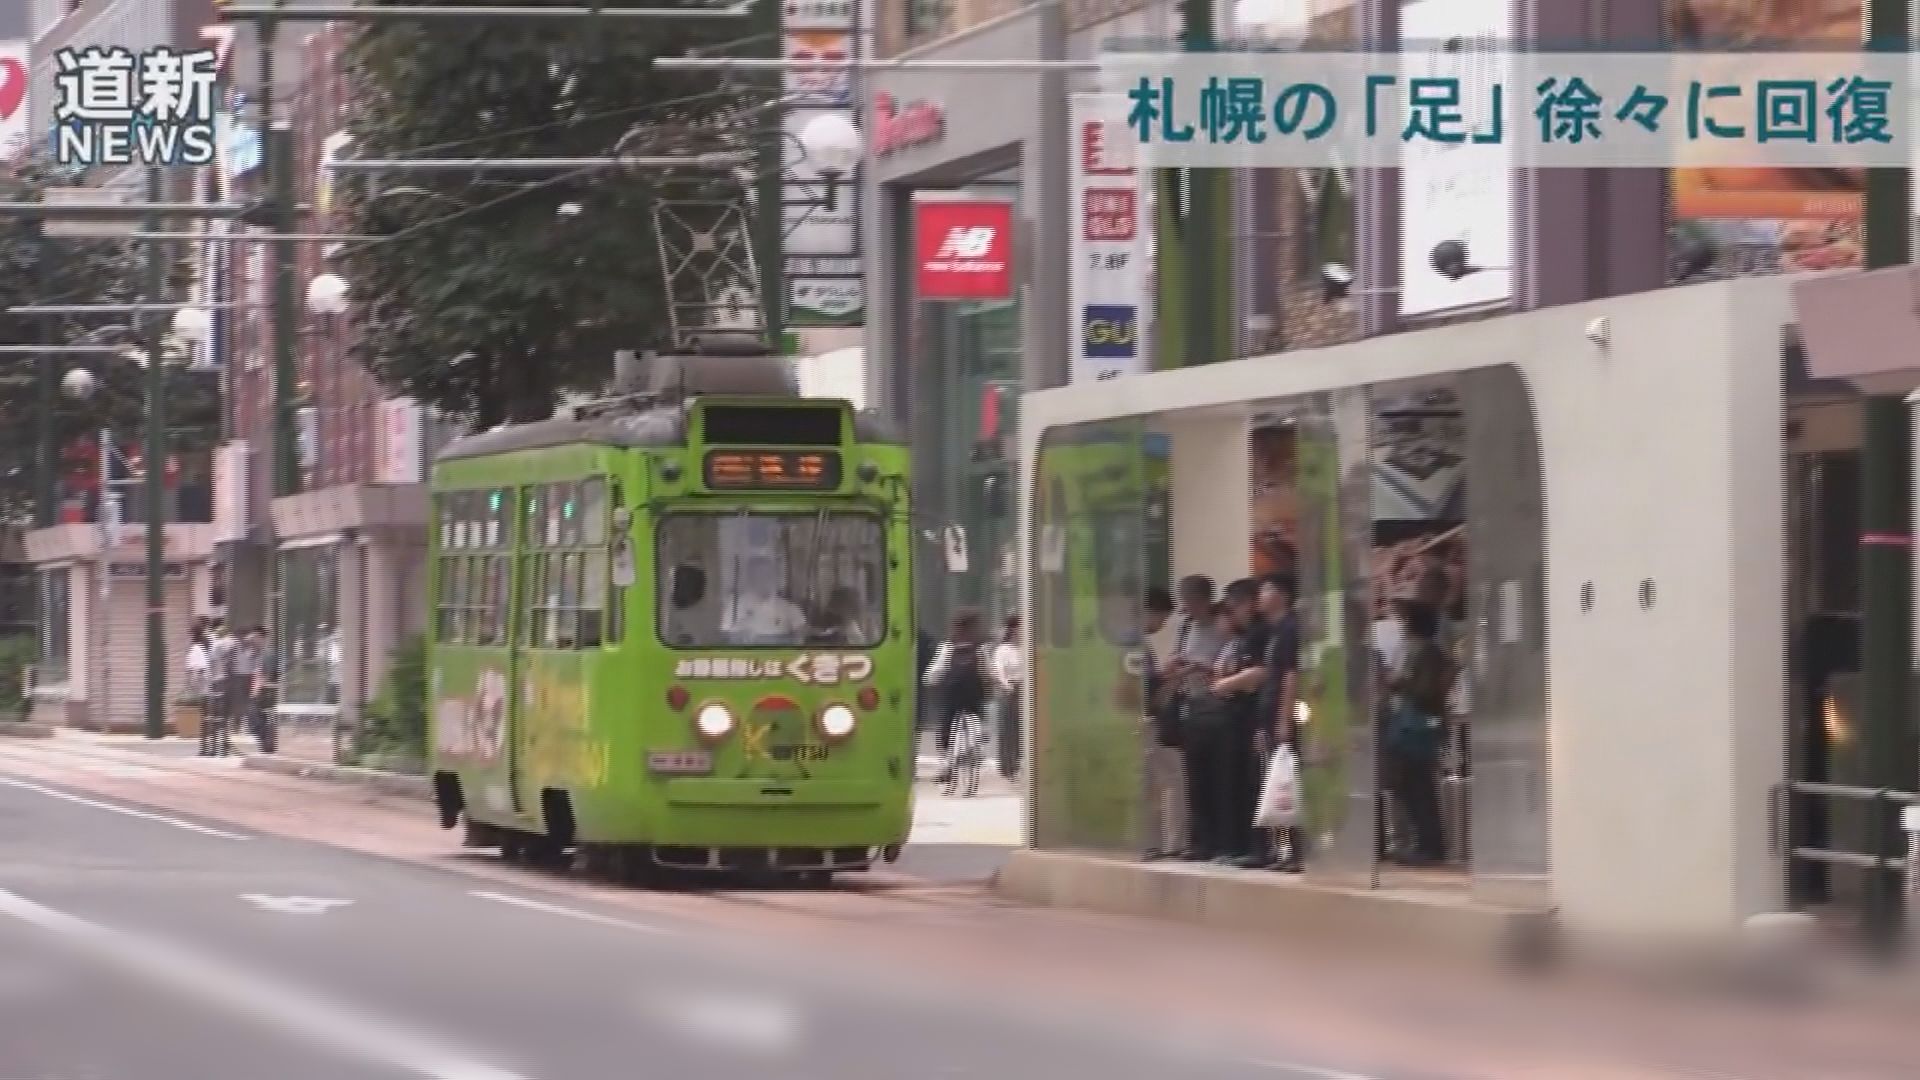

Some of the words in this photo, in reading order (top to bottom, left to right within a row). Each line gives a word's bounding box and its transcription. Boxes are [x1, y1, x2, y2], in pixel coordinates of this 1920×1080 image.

[1087, 319, 1137, 345] GU
[786, 653, 873, 683] くきつ
